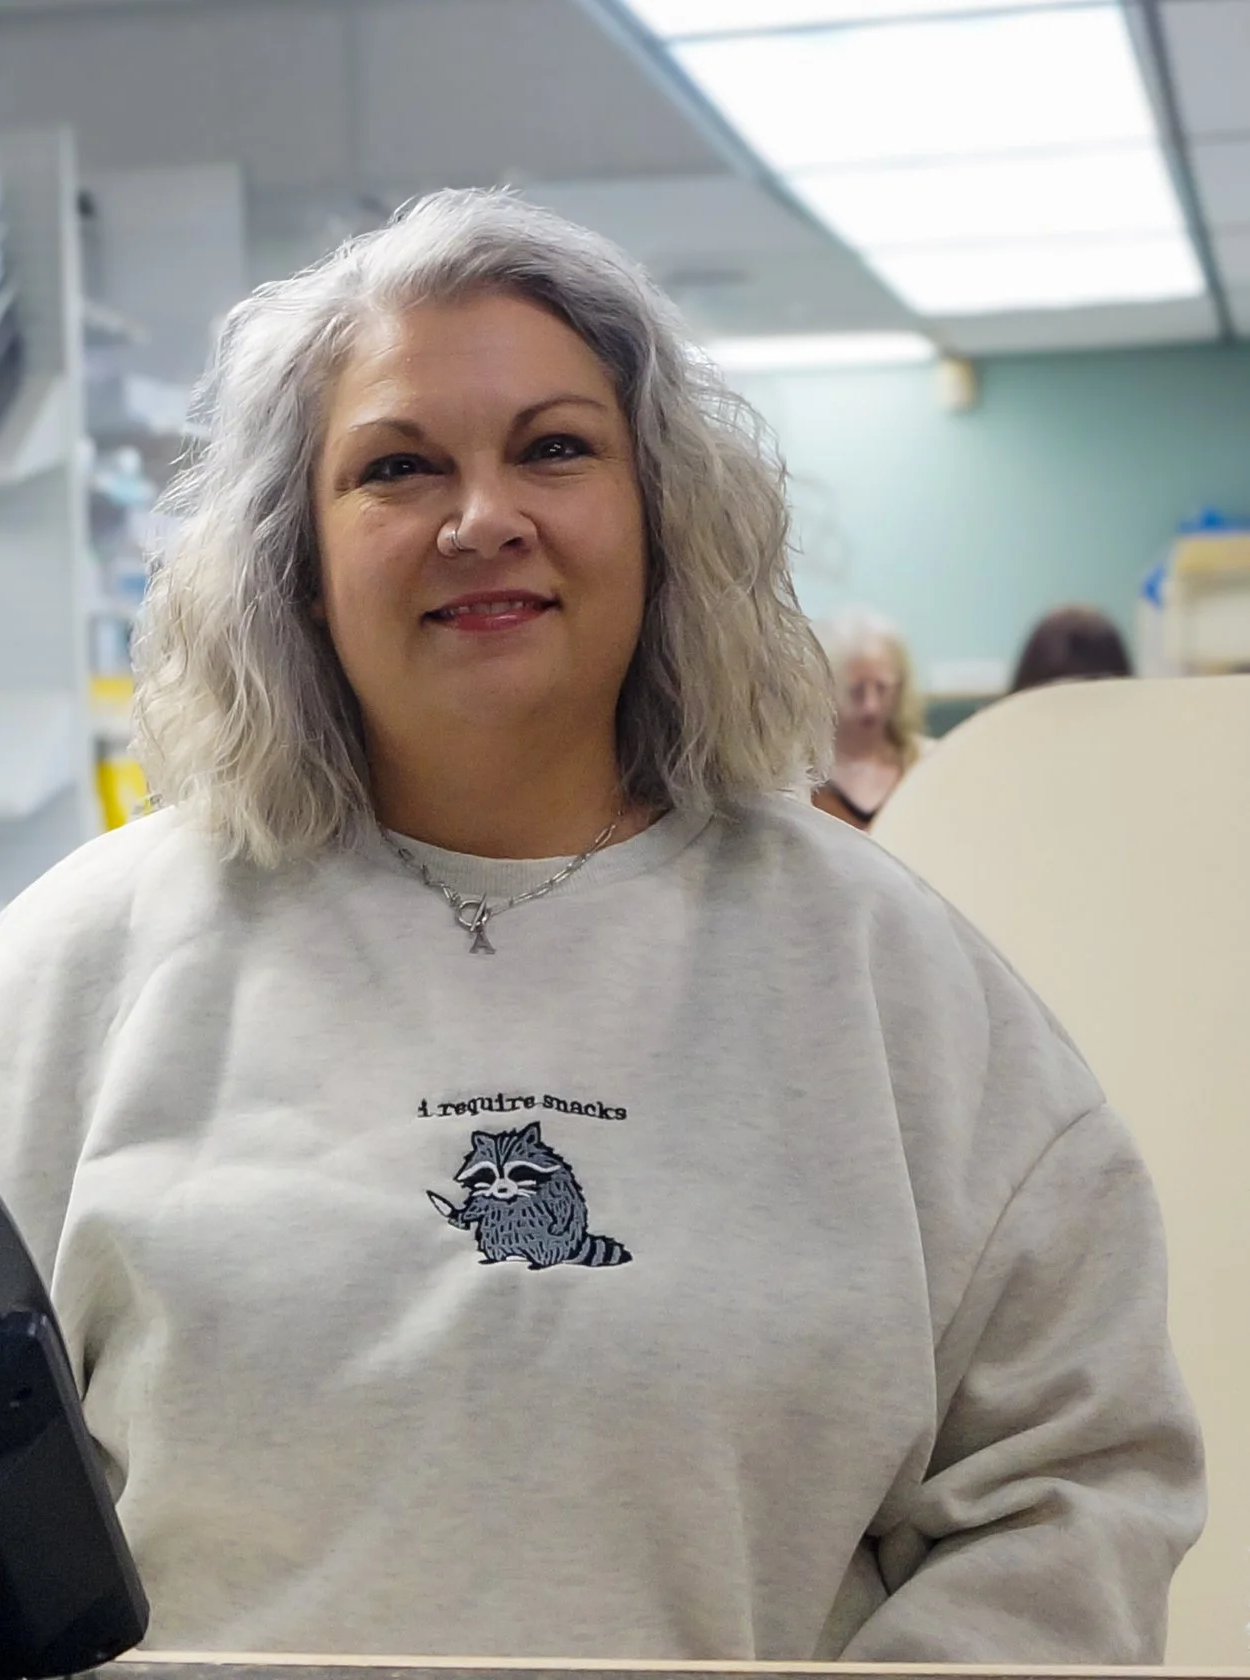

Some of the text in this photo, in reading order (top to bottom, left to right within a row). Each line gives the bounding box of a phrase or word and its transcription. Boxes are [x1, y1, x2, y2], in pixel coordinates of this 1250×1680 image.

[417, 1093, 627, 1120] i require snacks
